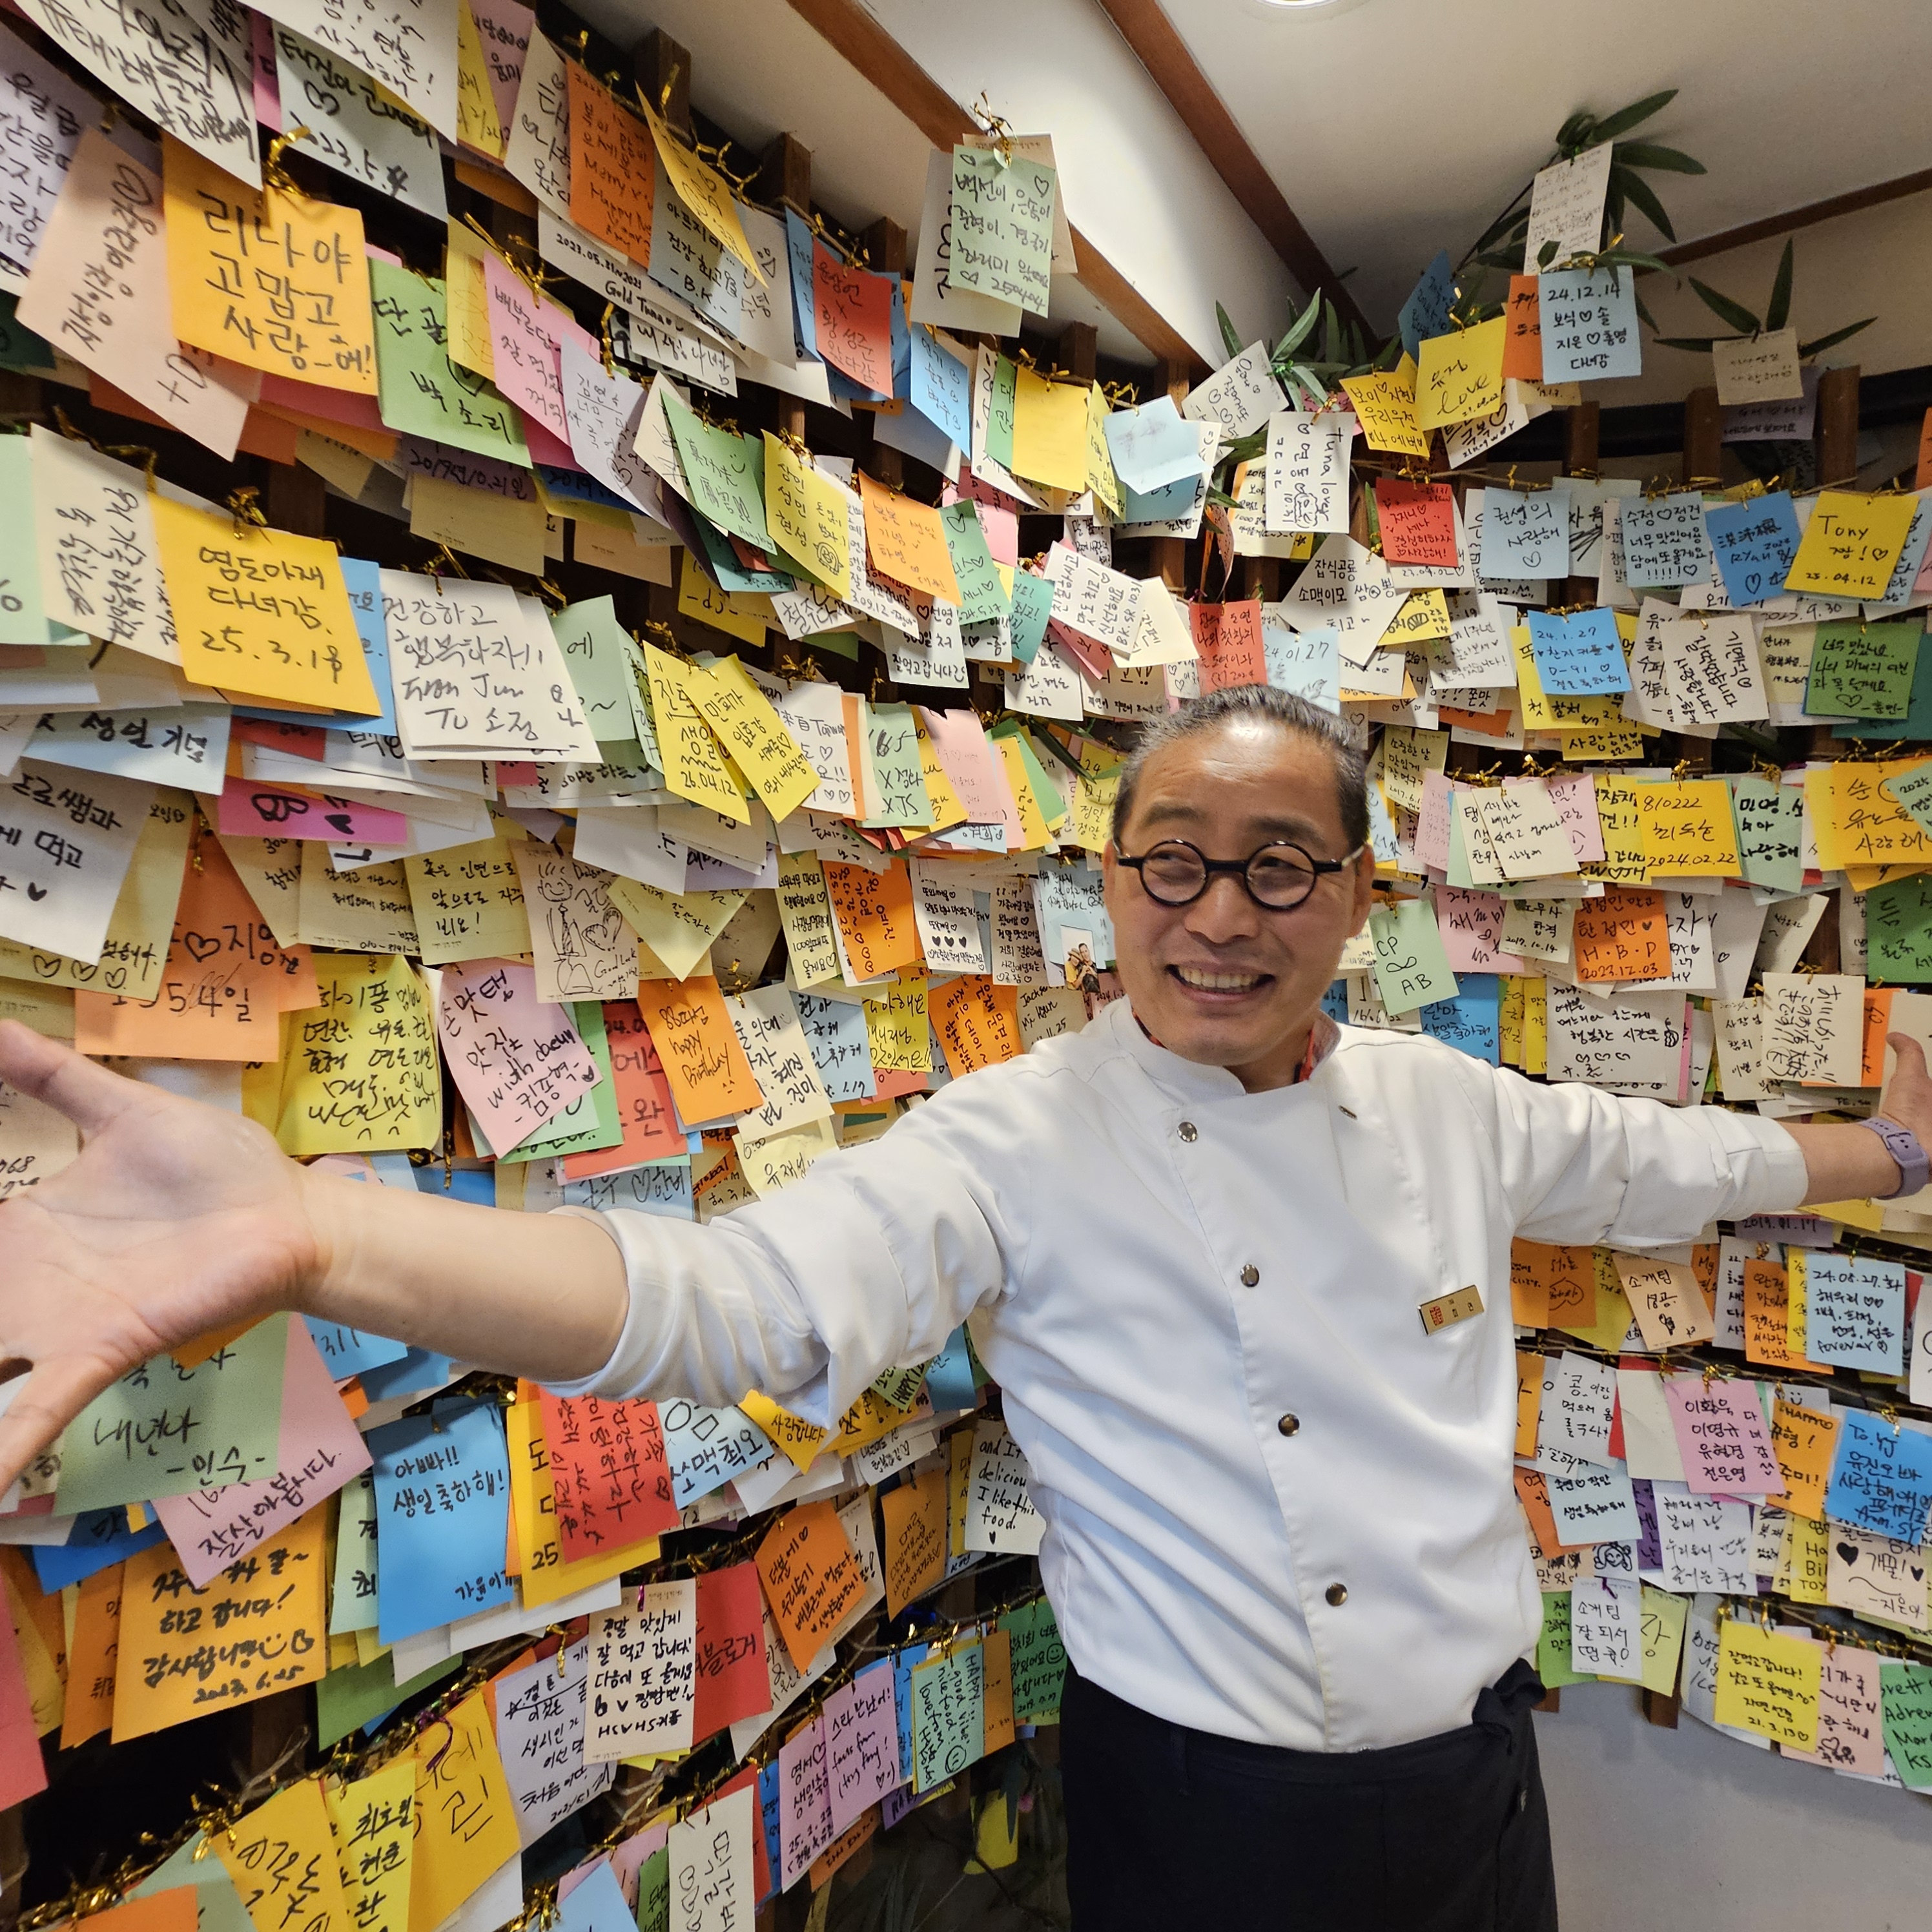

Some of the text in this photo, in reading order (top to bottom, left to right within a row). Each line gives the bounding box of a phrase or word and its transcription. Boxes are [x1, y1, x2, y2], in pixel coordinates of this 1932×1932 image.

[196, 190, 352, 284] 리나야
[205, 251, 340, 328] 고맙고
[1547, 282, 1622, 303] 24.12.14
[1507, 527, 1561, 548] 사랑해
[1817, 514, 1869, 541] Tony
[1629, 534, 1654, 548] 너무
[1805, 571, 1877, 586] 25.04.12
[1298, 588, 1348, 607] 소맥이모
[382, 595, 498, 627] 건강하고
[1643, 795, 1703, 812] 810222
[1647, 853, 1738, 868] 2024.02.22
[1376, 936, 1399, 958] CP
[1401, 973, 1433, 996] AB
[1628, 1269, 1672, 1289] 소개팅
[979, 1439, 1000, 1457] and
[978, 1461, 1027, 1488] deliciou
[991, 1489, 1012, 1510] like
[981, 1507, 1016, 1531] food.
[1577, 1601, 1620, 1621] 소개팅
[1575, 1624, 1594, 1641] 잘
[596, 1645, 611, 1665] 잘
[620, 1643, 644, 1663] 먹고
